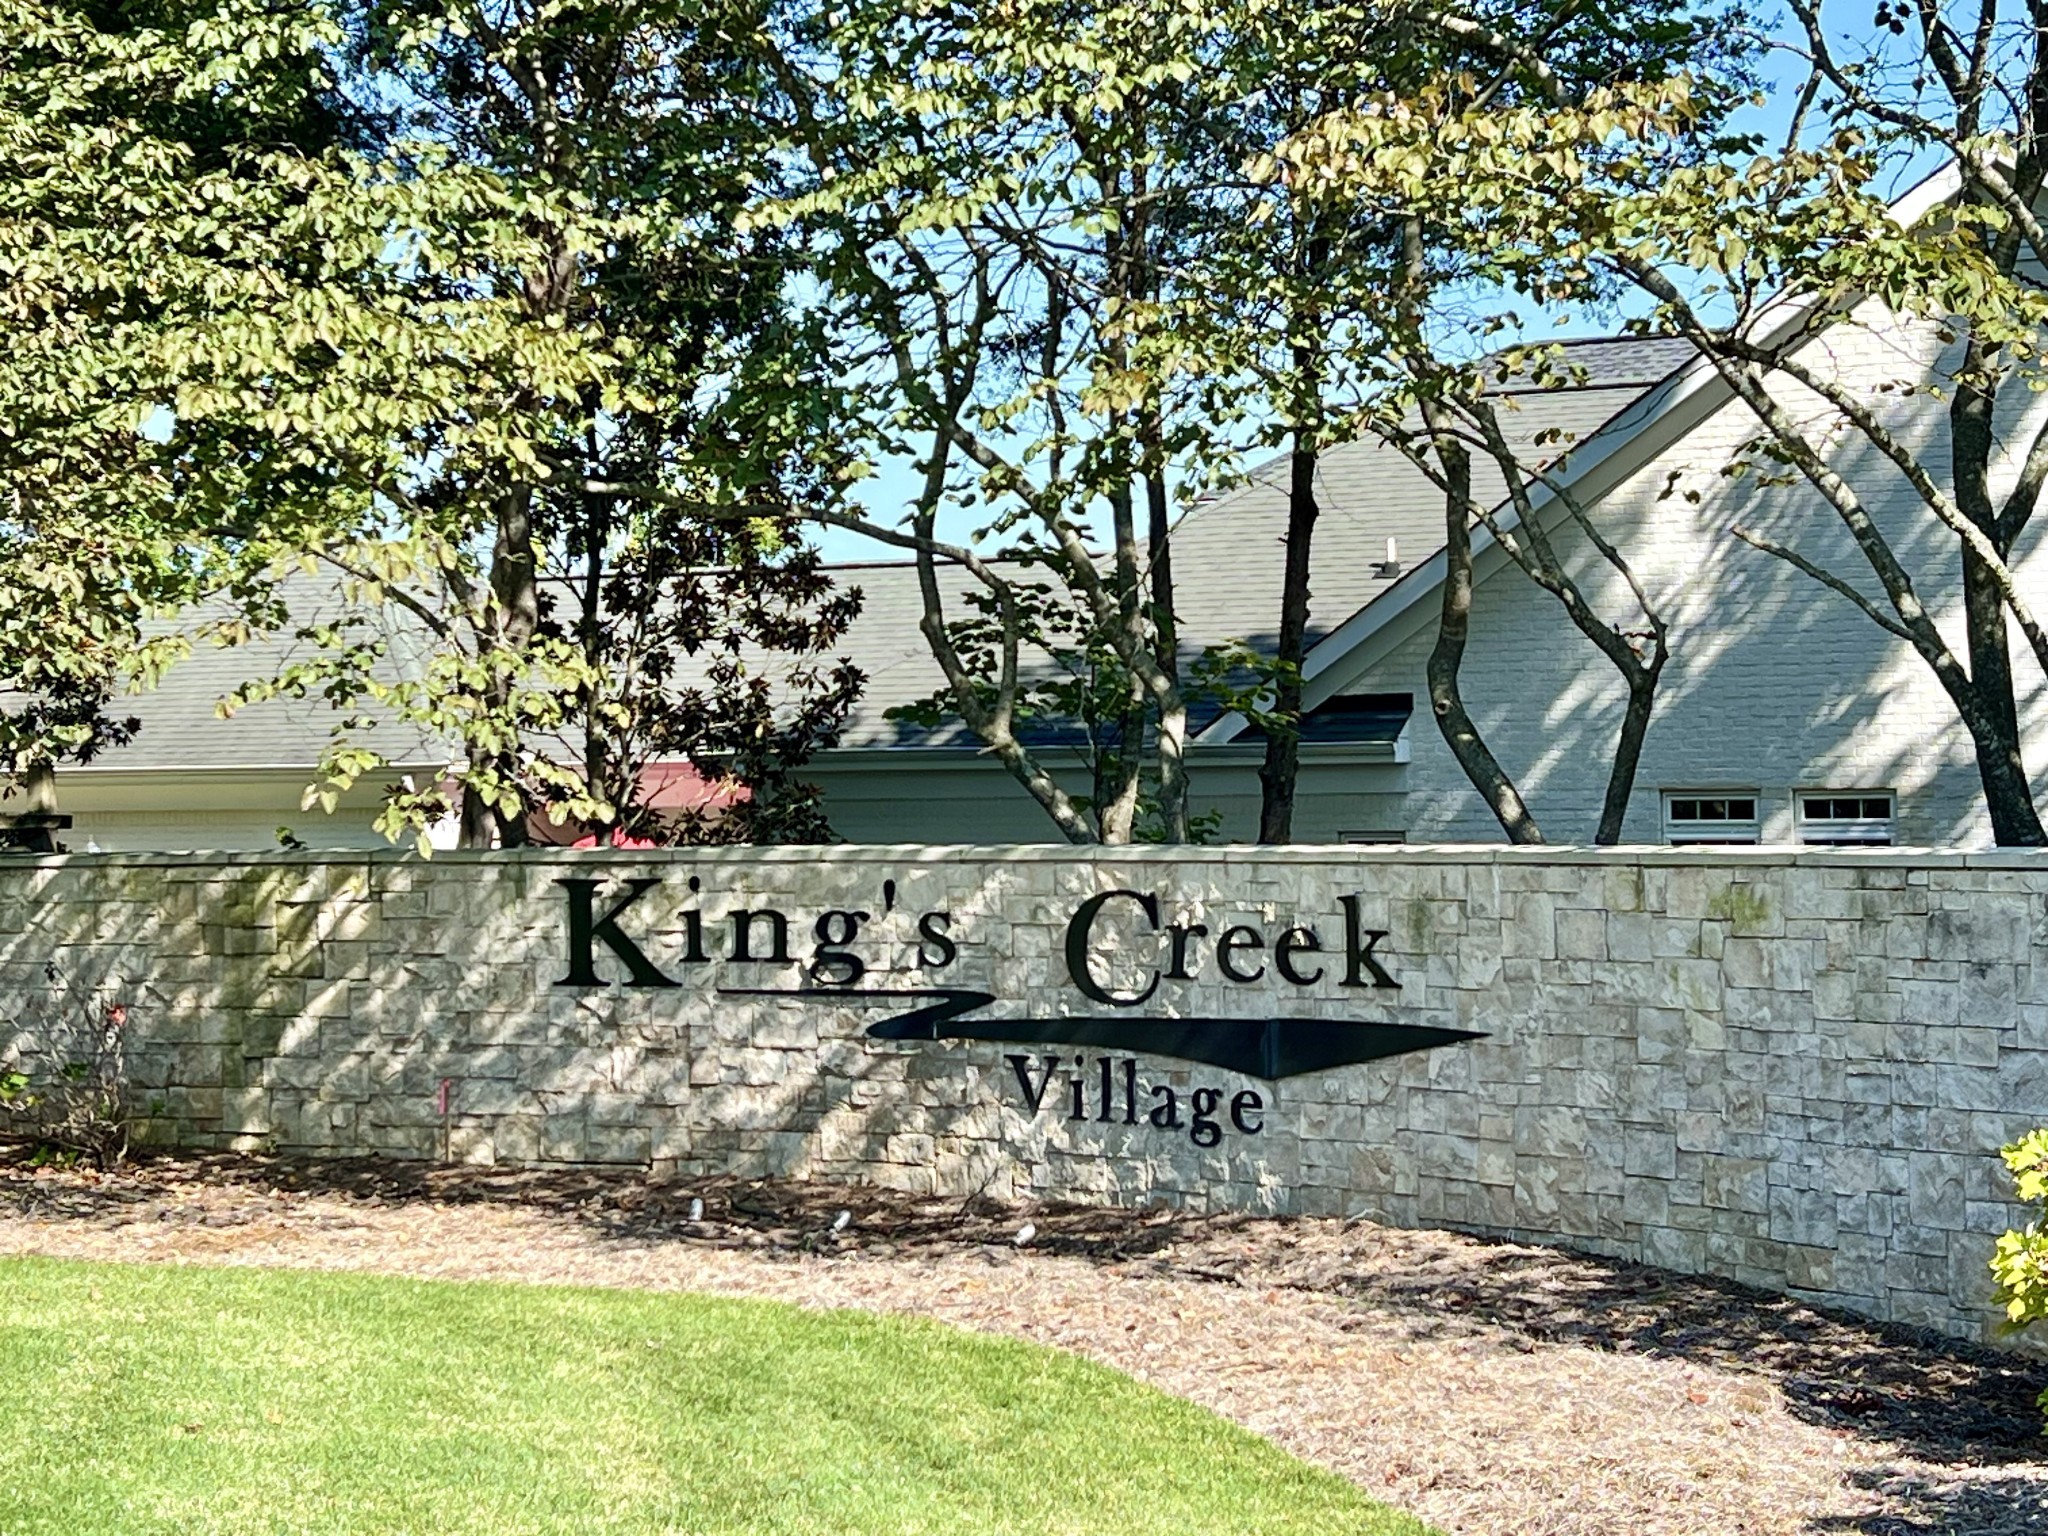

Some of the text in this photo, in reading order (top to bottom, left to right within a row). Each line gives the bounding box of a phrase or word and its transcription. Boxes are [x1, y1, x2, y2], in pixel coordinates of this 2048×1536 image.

[552, 876, 1402, 1006] King's Creek
[1007, 1056, 1264, 1147] Village
